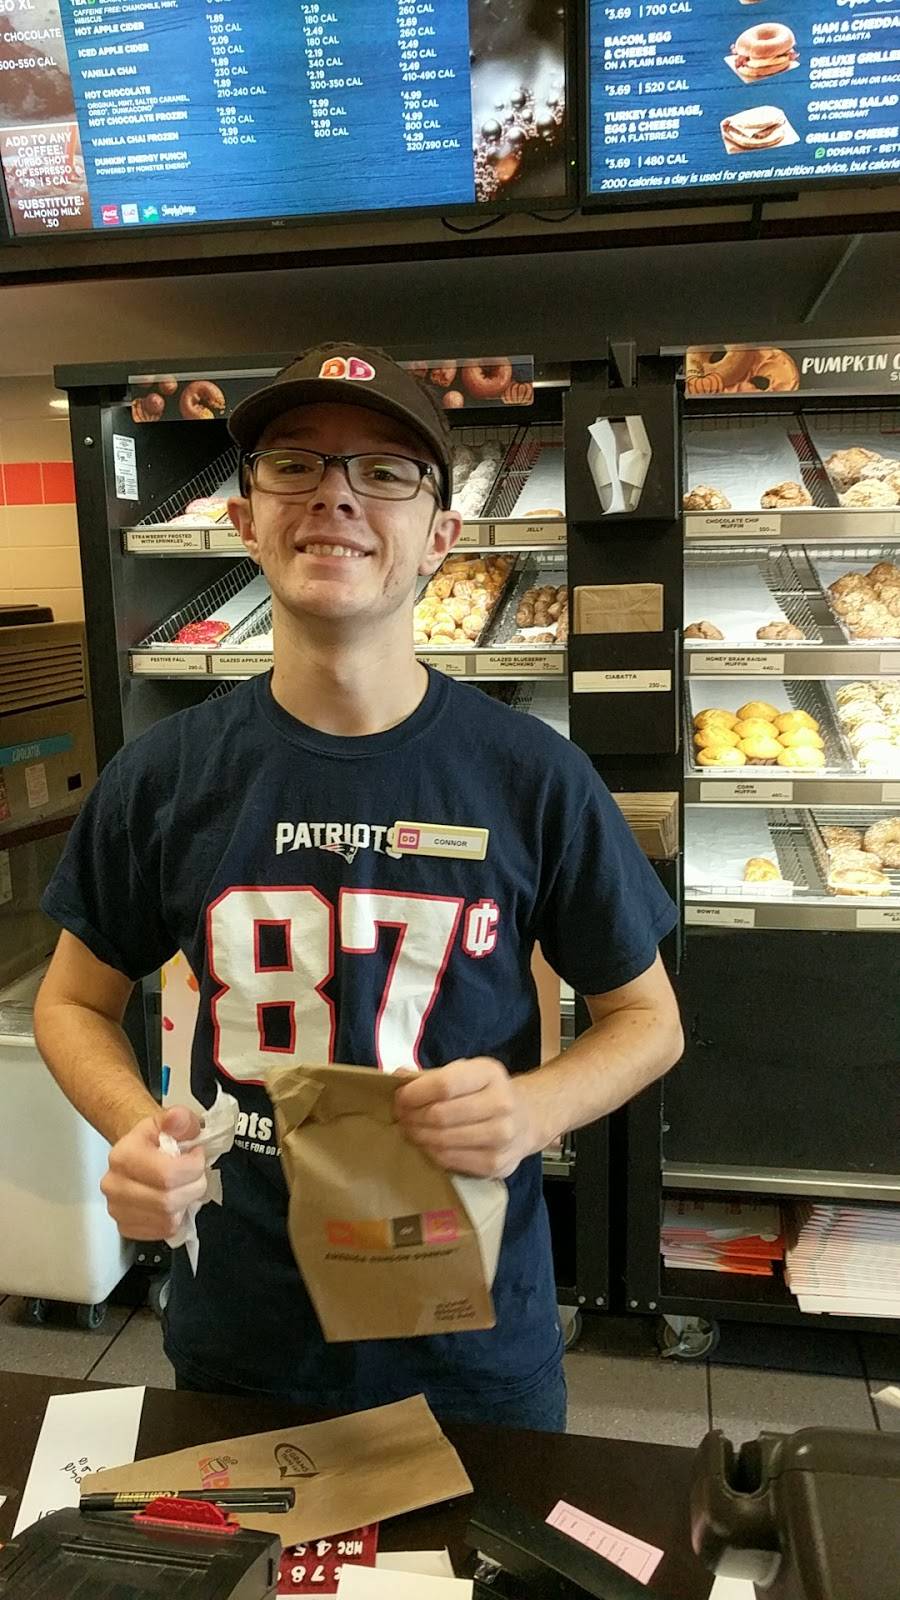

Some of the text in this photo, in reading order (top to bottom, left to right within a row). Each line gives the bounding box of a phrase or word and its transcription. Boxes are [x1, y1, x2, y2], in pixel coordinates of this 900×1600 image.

[73, 7, 103, 17] CAFFEINE
[398, 4, 435, 16] 260 CAL
[604, 2, 692, 20] $3.69 700 CAL
[74, 16, 103, 25] HIBISCUS
[304, 13, 338, 24] 180 CAL
[74, 21, 145, 37] HOT APPLE CIDER
[210, 22, 243, 34] 120 CAL
[417, 26, 436, 36] CAL
[812, 21, 840, 36] HAM
[4, 28, 63, 43] CHOCOLATE
[306, 35, 340, 47] 180 CAL
[604, 31, 672, 47] BACON, EGG
[78, 43, 150, 58] ICED APPLE CIDER
[212, 44, 245, 56] 120 CAL
[401, 48, 437, 60] 450 CAL
[613, 45, 657, 59] CHEESE
[36, 55, 57, 67] CAL
[308, 57, 344, 69] 340 CAL
[604, 55, 686, 70] ON A PLAIN BAGEL
[810, 53, 857, 69] DELUXE
[81, 65, 137, 80] VANILLA CHAI
[215, 66, 249, 77] 230 CAL
[402, 69, 456, 81] 410-490 CAL
[310, 77, 364, 90] 300-350 CAL
[604, 79, 690, 97] $3.69 520 CAL
[85, 86, 152, 100] HOT CHOCOLATE
[217, 85, 268, 98] 210-240 CAL
[403, 98, 440, 110] 790 CAL
[807, 95, 899, 113] CHICKEN SALAD
[312, 106, 348, 118] 590 CAL
[604, 104, 704, 123] TURKEY SAUSAGE,
[88, 111, 188, 128] HOT CHOCOLATE FROZEN
[220, 114, 255, 125] 400 CAL
[423, 119, 441, 129] CAL
[332, 127, 350, 137] CAL
[604, 119, 680, 135] EGG CHEESE
[6, 131, 73, 148] ADD TO ANY
[92, 131, 180, 147] VANILLA CHAI FROZEN
[223, 135, 257, 146] 400 CAL
[604, 131, 680, 145] ON A FLATBREAD
[805, 126, 900, 145] GRILLED CHEESE
[18, 144, 64, 158] COFFEE:
[442, 139, 460, 149] CAL
[159, 151, 188, 162] PUNCH
[605, 153, 689, 169] $3.69 480 CAL
[16, 164, 72, 178] OF ESPRESSO
[600, 157, 869, 190] 2000 calories a day is used for general nutrition advice, but
[52, 174, 72, 186] CAL
[18, 195, 85, 211] SUBSTITUTE:
[23, 206, 82, 220] ALMOND MILK
[318, 356, 376, 381] DD
[802, 352, 888, 375] PUMPKIN
[434, 838, 469, 848] CONNOR
[206, 886, 465, 1085] 87
[250, 1142, 266, 1154] FOR
[316, 1540, 333, 1557] 4
[290, 1565, 307, 1583] 8
